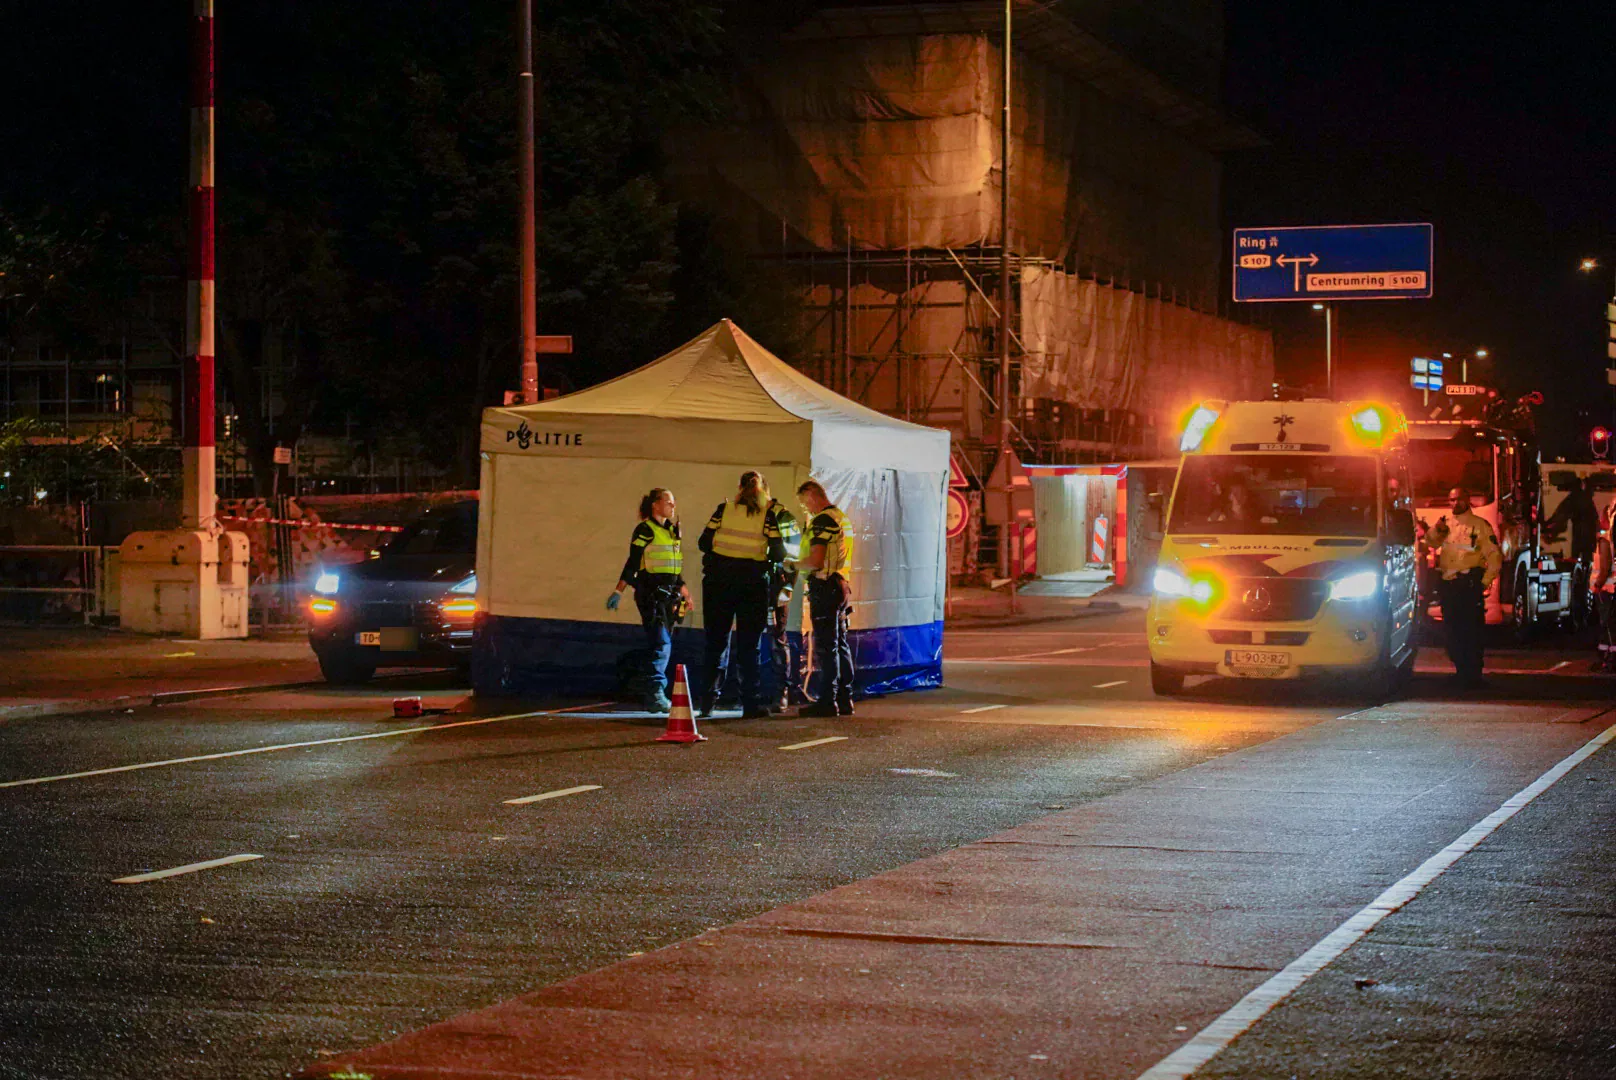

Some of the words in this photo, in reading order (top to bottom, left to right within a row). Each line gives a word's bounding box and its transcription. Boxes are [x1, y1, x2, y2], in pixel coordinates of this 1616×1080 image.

[1239, 236, 1266, 250] Ring
[1251, 257, 1267, 265] 107
[1310, 274, 1385, 287] Centrumring
[1399, 276, 1419, 284] 100
[506, 420, 583, 450] POLITIE
[1219, 544, 1312, 552] AMBULANCE
[1235, 652, 1285, 664] L-903-RZ
